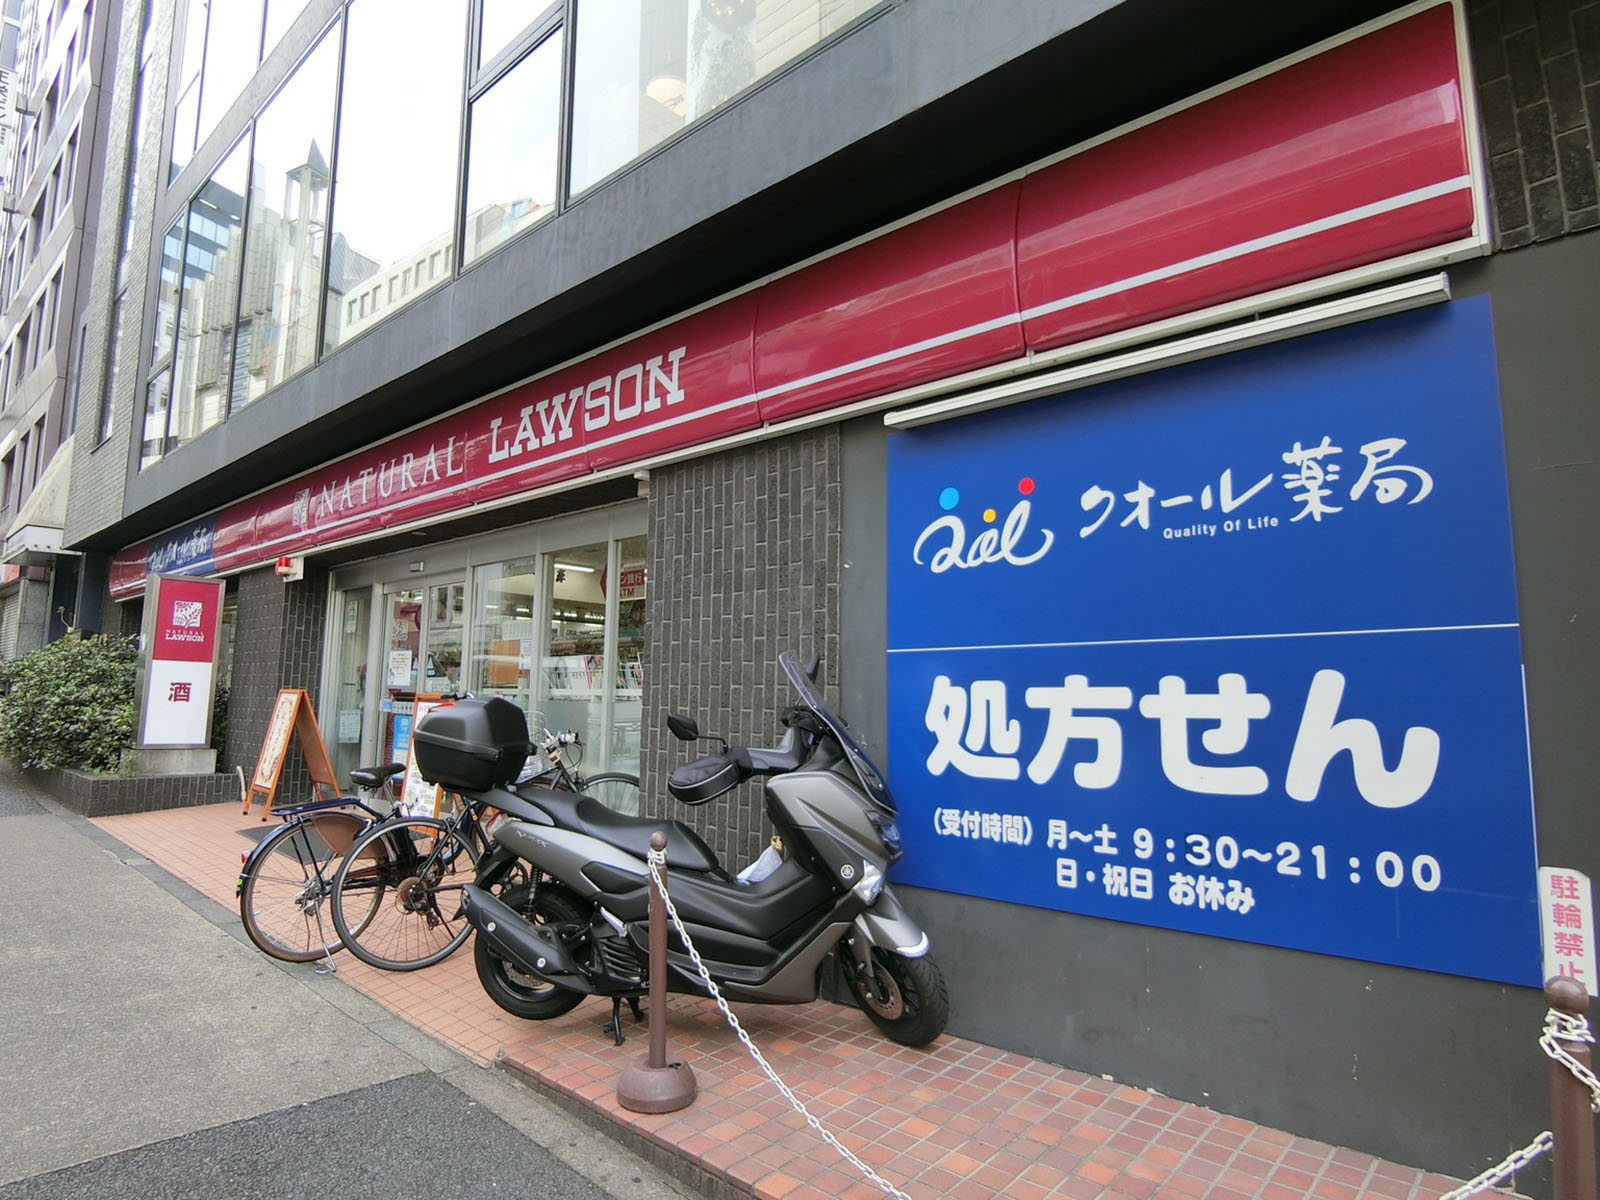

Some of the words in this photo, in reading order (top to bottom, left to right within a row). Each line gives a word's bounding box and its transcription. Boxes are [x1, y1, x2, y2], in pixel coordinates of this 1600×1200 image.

[319, 436, 464, 517] NATURAL
[488, 346, 687, 464] LAWSON
[1079, 435, 1434, 538] クオール薬局
[1163, 524, 1216, 539] Quality
[1223, 519, 1240, 532] Of
[1247, 515, 1279, 530] Life
[165, 634, 204, 642] LAWSON
[168, 682, 192, 702] 酒
[925, 669, 1440, 808] 処方せん
[934, 807, 1033, 846] (受付時間)
[1047, 819, 1118, 855] 月〜土
[1056, 858, 1153, 900] 日・祝日
[1168, 872, 1255, 915] お休み
